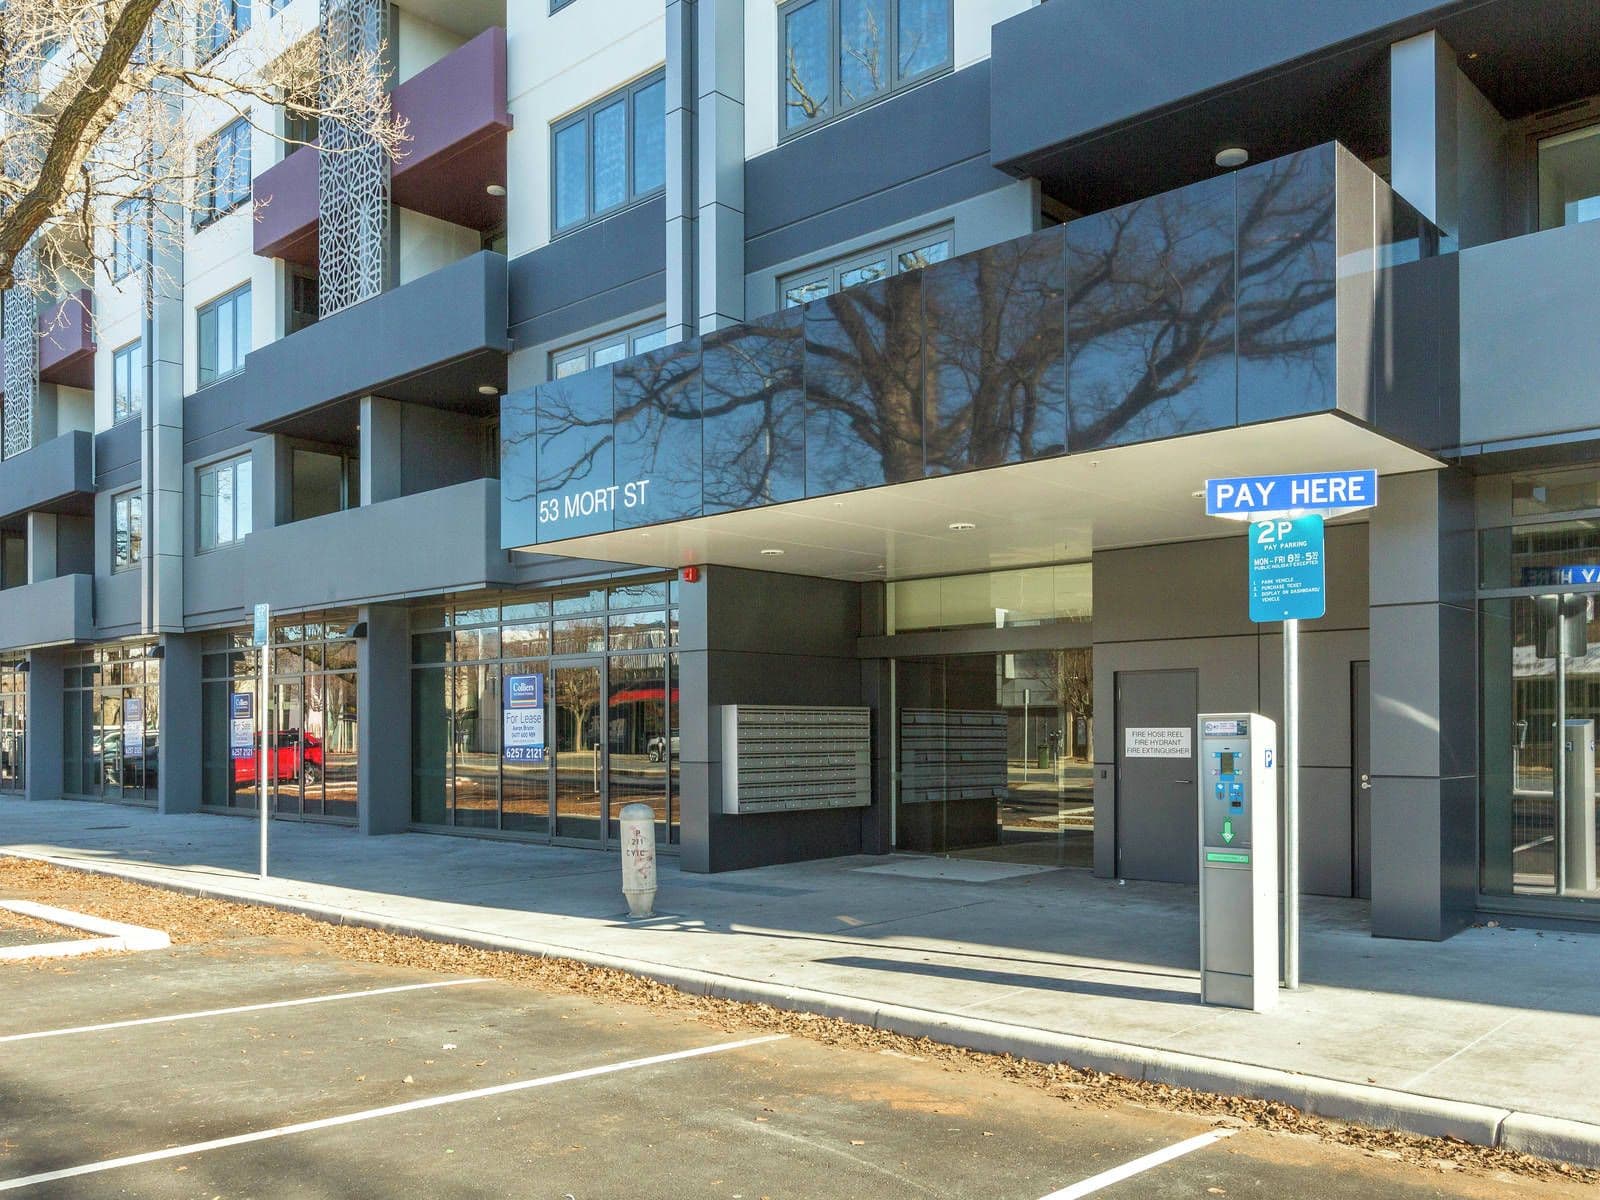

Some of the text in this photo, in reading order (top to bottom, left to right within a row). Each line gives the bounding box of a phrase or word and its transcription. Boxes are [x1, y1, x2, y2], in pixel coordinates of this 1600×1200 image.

[1217, 476, 1365, 508] PAY HERE
[540, 480, 650, 523] 53 MORT ST
[1257, 521, 1292, 544] 2P
[1280, 541, 1307, 549] PARKING
[513, 682, 534, 692] Colliers
[506, 712, 542, 724] For Lease
[506, 748, 542, 758] 6257 2121
